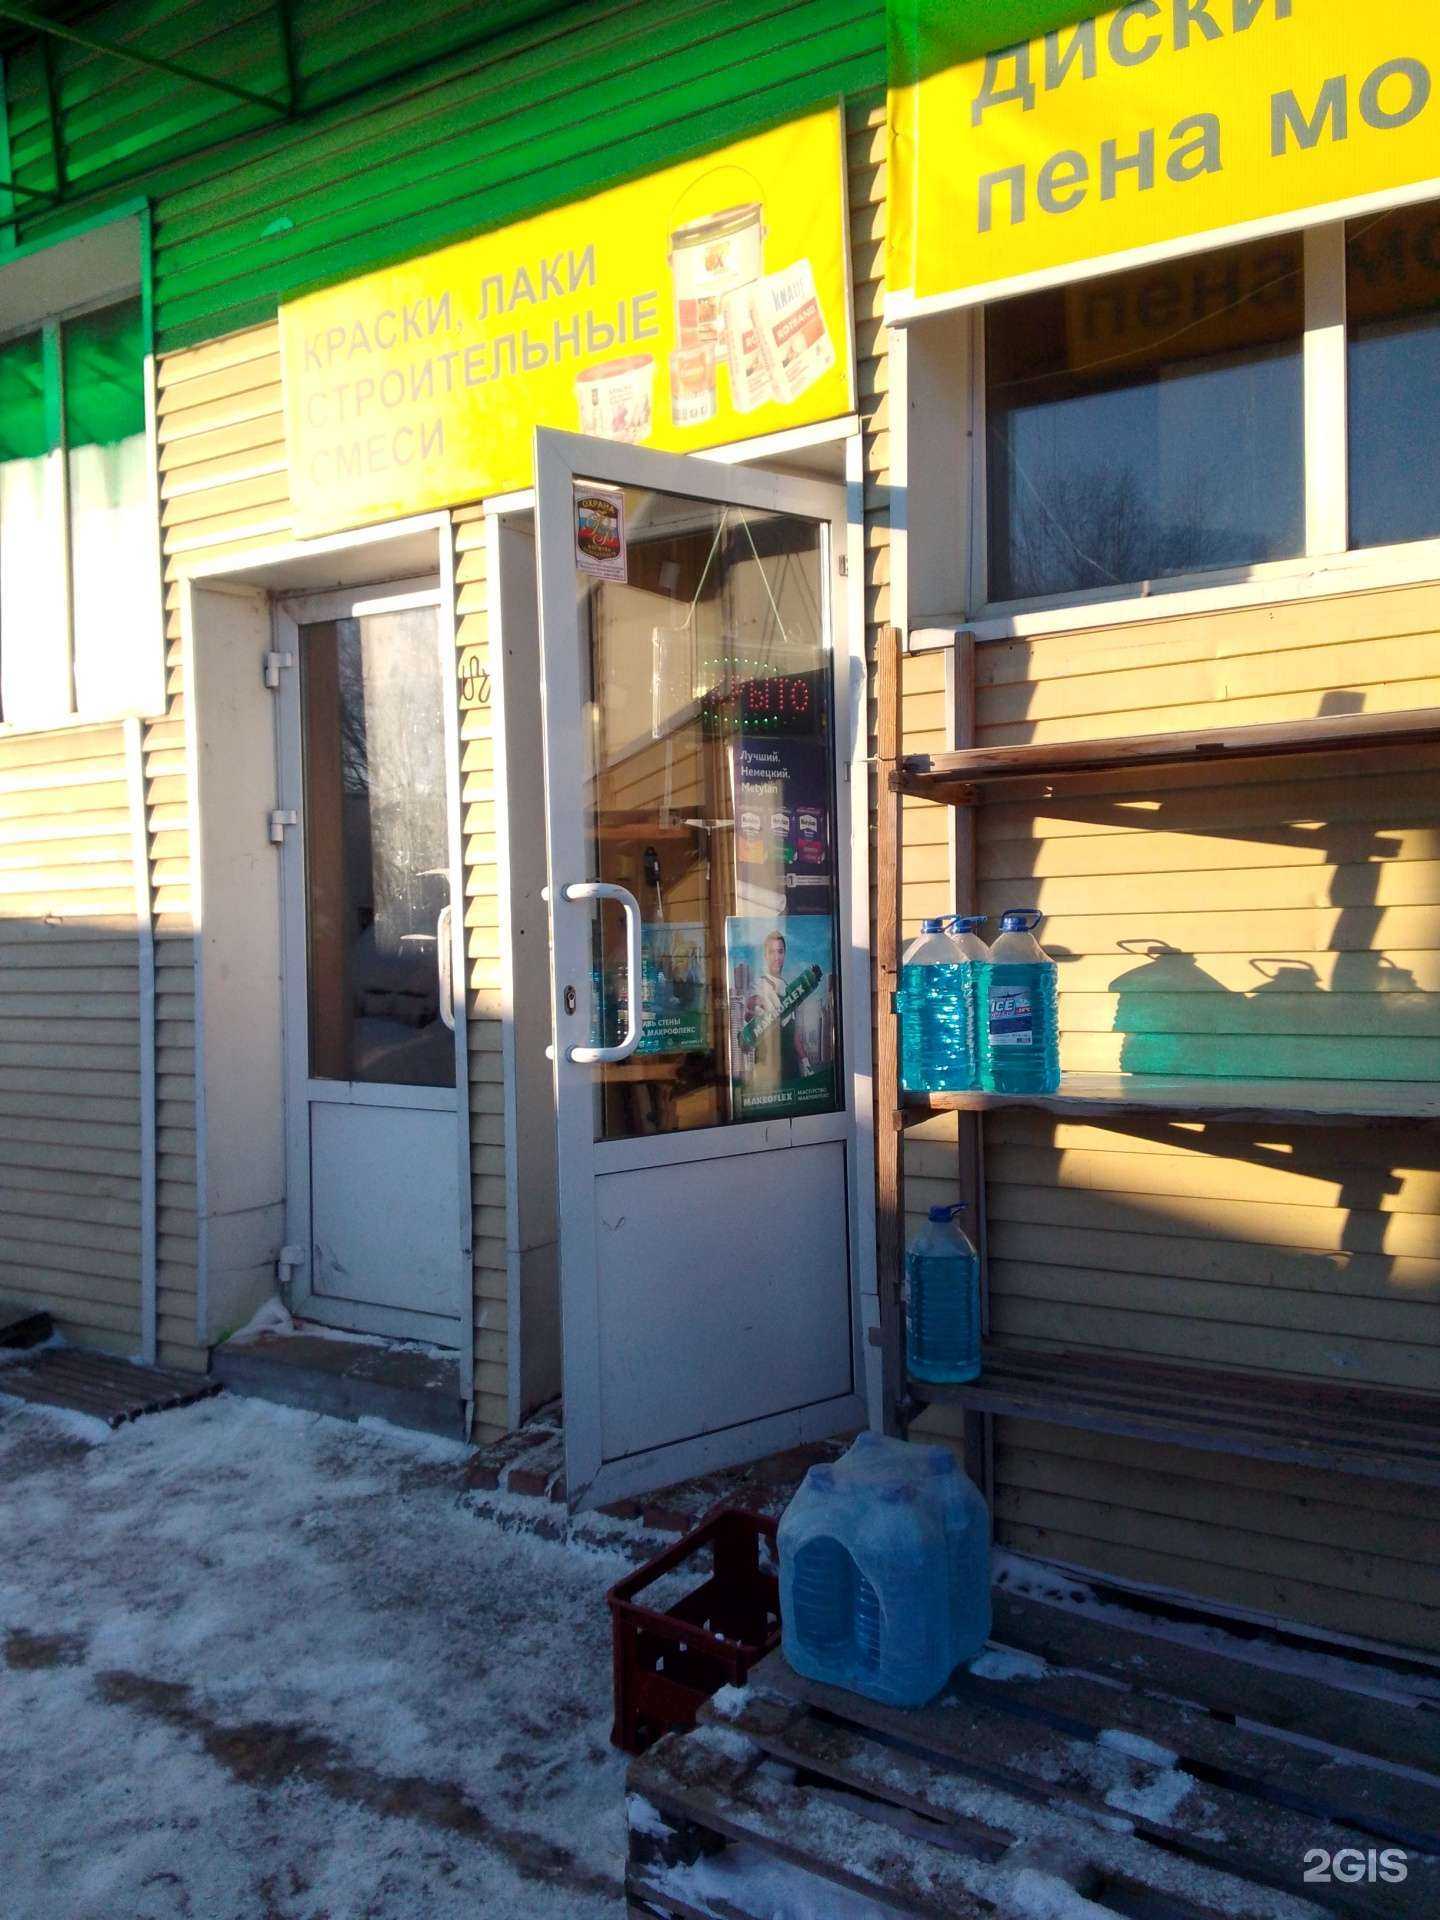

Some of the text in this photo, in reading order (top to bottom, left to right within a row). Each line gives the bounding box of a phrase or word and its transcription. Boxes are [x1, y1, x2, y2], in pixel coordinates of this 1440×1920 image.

[977, 111, 1224, 233] пена
[303, 243, 597, 371] КРАСКИ, ЛАКИ
[306, 291, 660, 429] СТРОИТЕЛЬНЫЕ
[309, 418, 445, 487] СМЕСИ
[742, 782, 778, 796] Metylan
